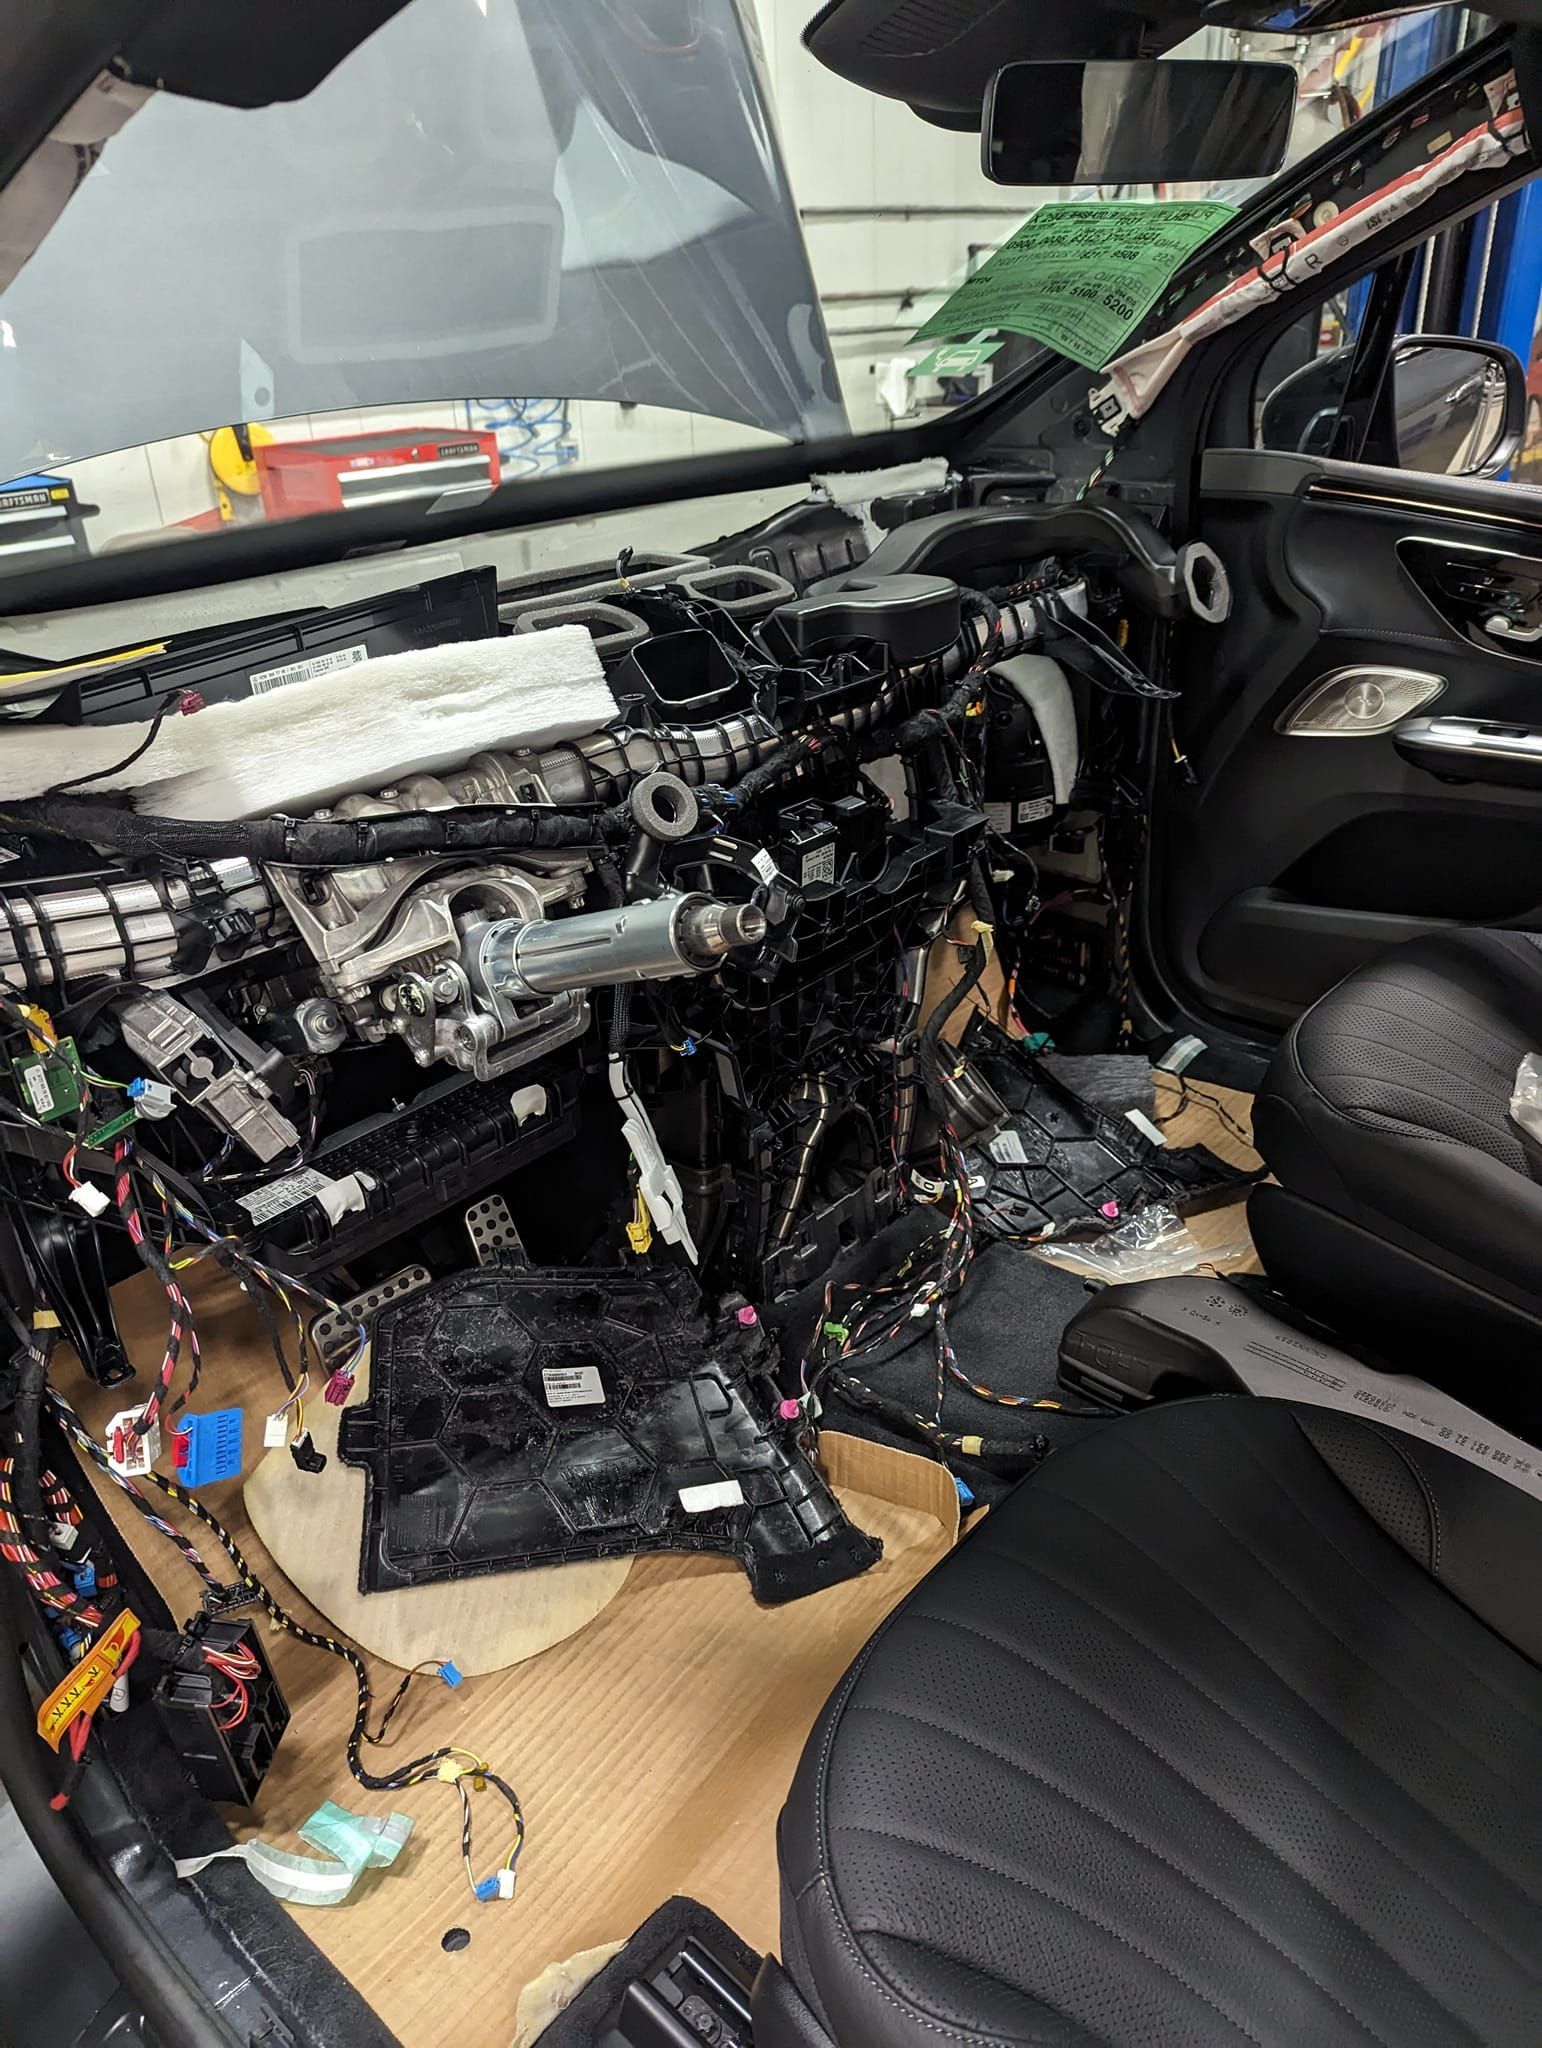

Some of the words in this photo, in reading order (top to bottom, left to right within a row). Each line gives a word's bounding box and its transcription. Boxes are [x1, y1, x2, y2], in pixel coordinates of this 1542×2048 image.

[1304, 254, 1323, 270] R
[1069, 286, 1098, 299] 5100
[1102, 294, 1134, 321] 5200
[440, 445, 478, 457] CRAFTSMAN
[0, 492, 47, 508] AFTSMAN
